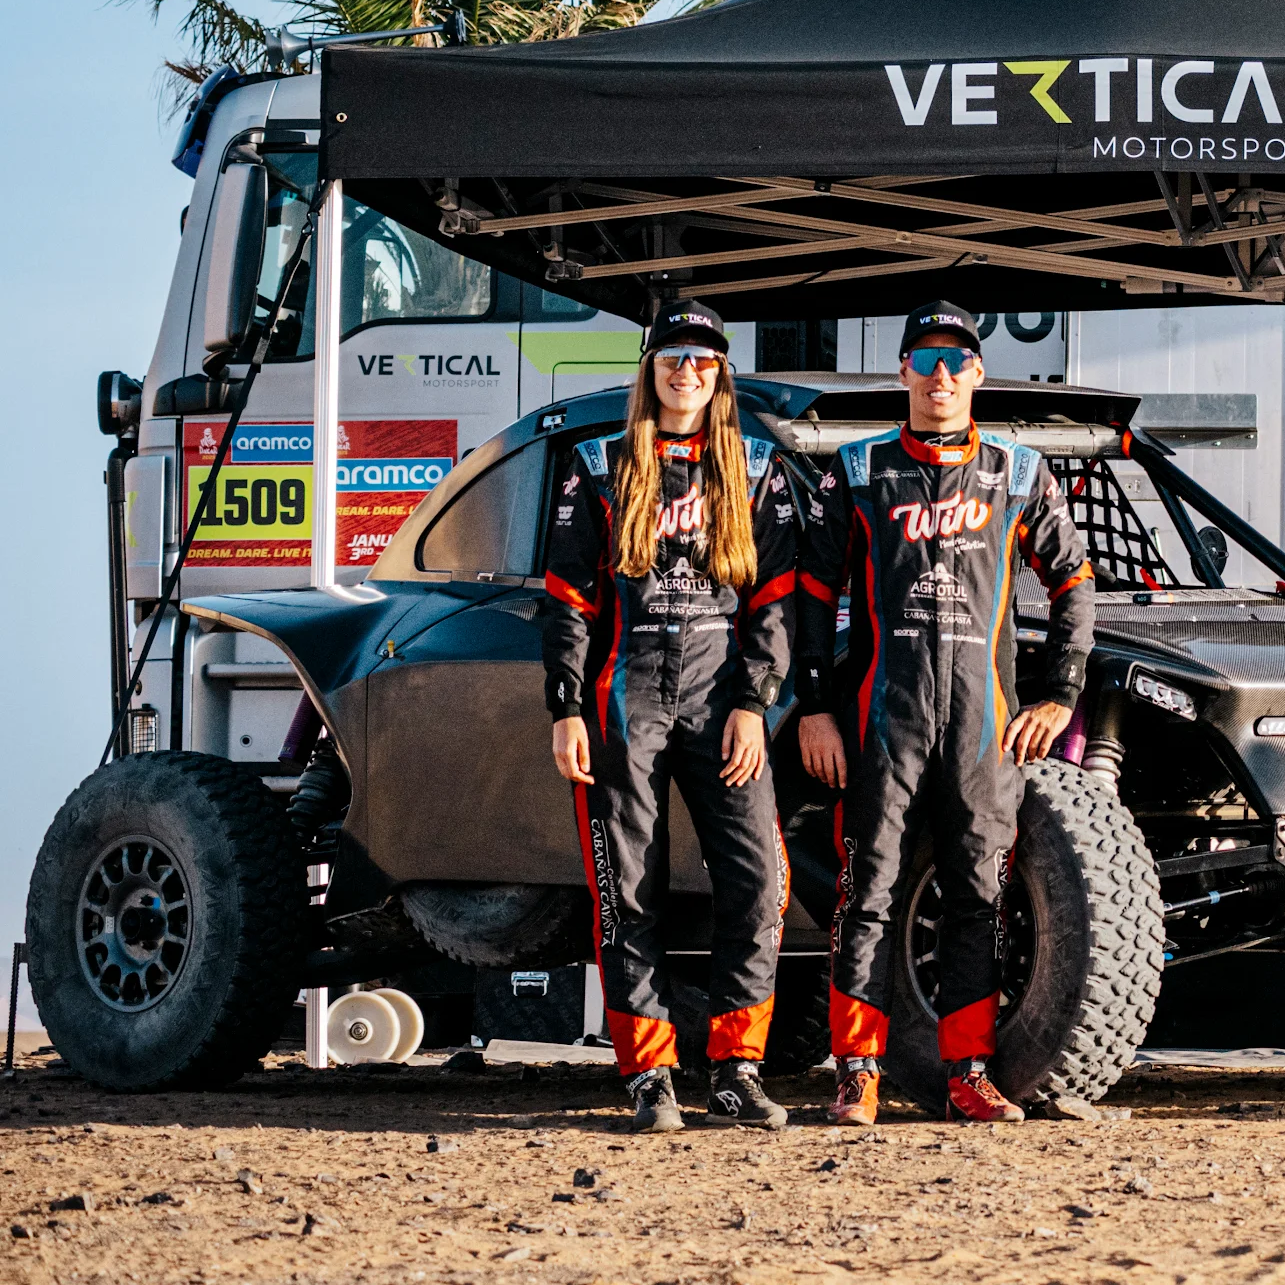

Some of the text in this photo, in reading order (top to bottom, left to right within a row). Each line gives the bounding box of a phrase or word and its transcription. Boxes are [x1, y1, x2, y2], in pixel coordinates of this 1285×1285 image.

[358, 355, 500, 376] VERTICAL
[423, 380, 499, 388] MOTORSPORT
[236, 437, 311, 450] aramco
[1016, 454, 1030, 487] sparco
[198, 479, 305, 526] 1509
[336, 507, 370, 515] REAM.
[372, 506, 406, 515] DARE.
[888, 490, 993, 543] Win
[347, 534, 393, 547] JANU
[188, 549, 232, 558] DREAM.
[236, 548, 271, 558] DARE.
[274, 548, 299, 557] LIVE
[655, 578, 713, 591] AGROTUL
[911, 581, 967, 597] AGROTUL
[591, 819, 608, 887] CABAÑAS
